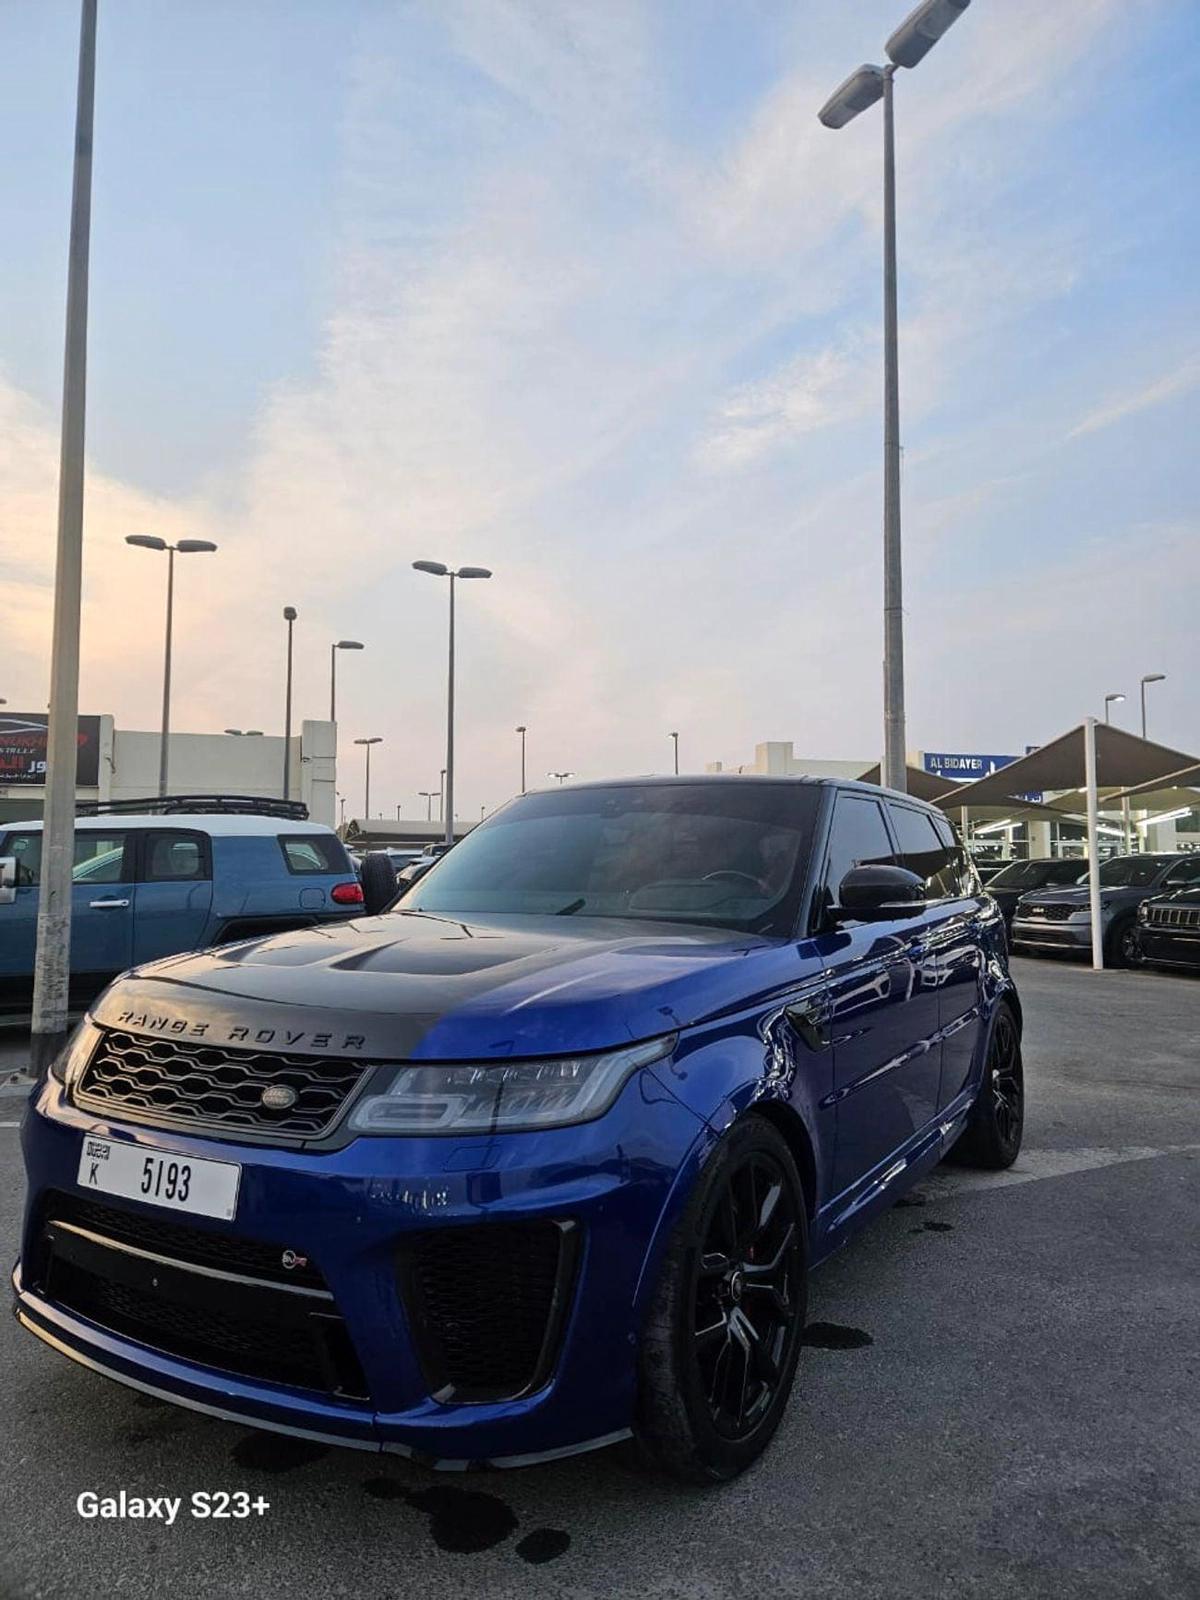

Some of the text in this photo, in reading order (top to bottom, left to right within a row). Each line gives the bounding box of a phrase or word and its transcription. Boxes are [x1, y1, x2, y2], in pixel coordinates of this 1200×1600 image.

[930, 758, 942, 769] AL
[944, 758, 983, 770] BIDAYER
[116, 1010, 367, 1051] RANGE ROVER
[88, 1162, 100, 1186] K
[141, 1157, 192, 1202] 5193
